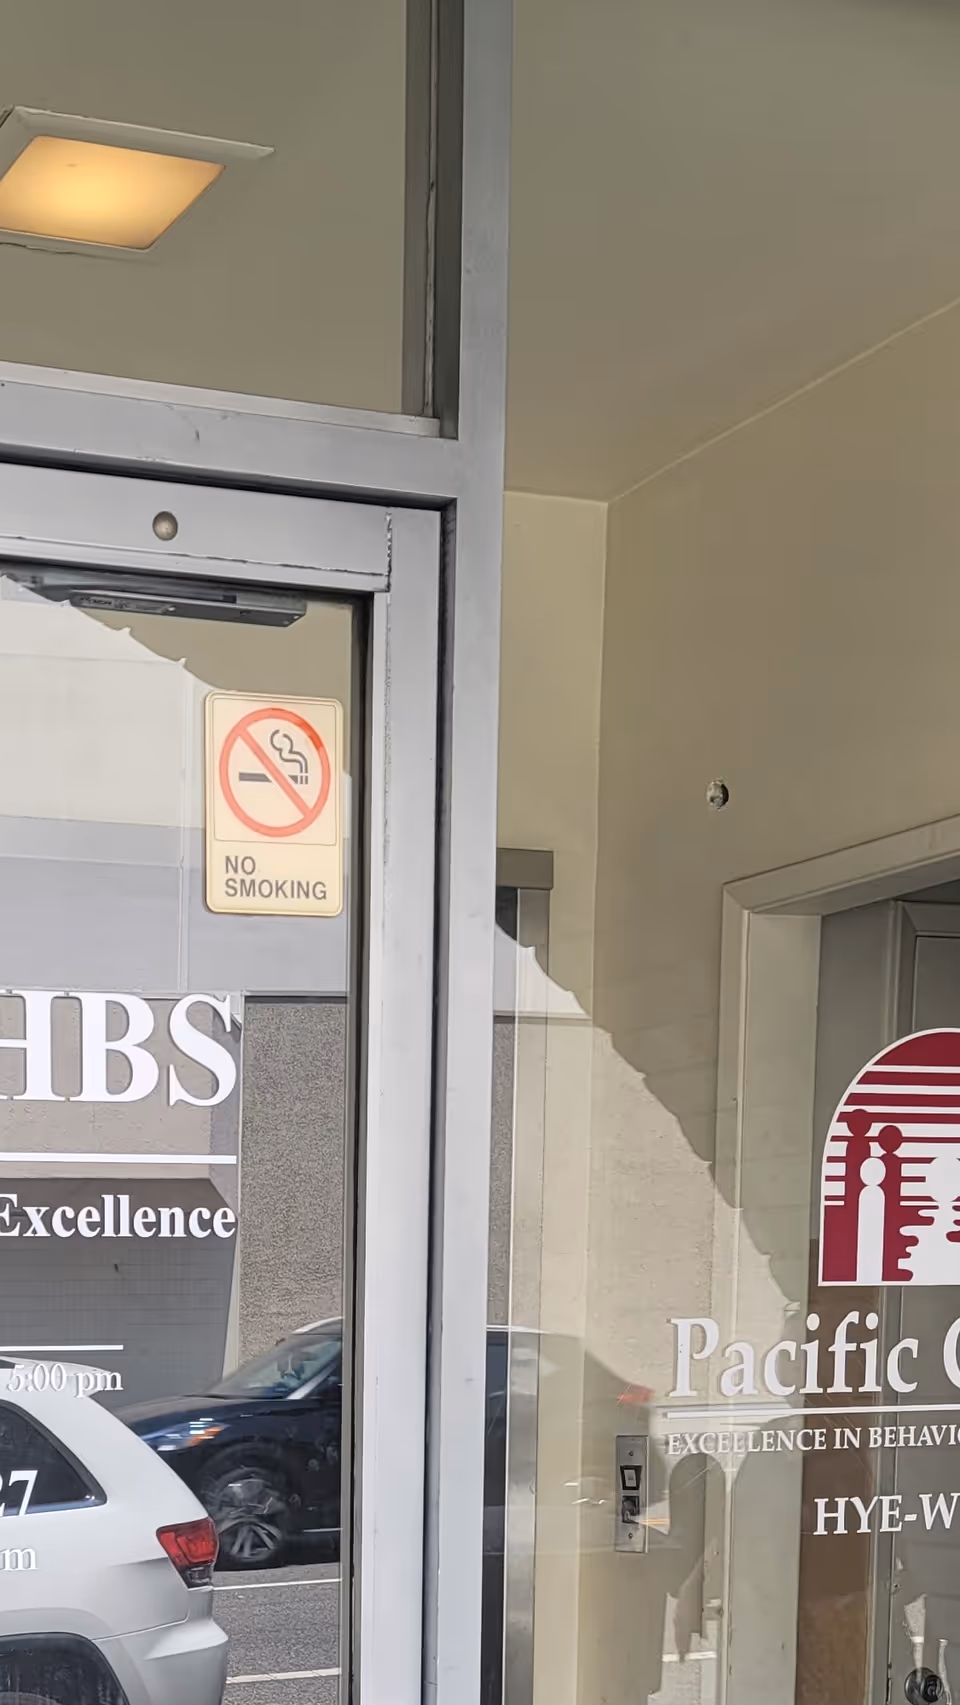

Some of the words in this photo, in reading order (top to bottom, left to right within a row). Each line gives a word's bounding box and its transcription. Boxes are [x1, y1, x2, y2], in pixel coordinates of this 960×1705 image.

[225, 855, 257, 876] NO
[224, 878, 328, 900] SMOKING
[666, 1310, 920, 1399] Pacific
[7, 1363, 67, 1392] 5:00
[74, 1370, 124, 1398] pm
[668, 1427, 828, 1456] EXCELLENCE
[833, 1427, 863, 1449] IN
[813, 1493, 960, 1536] HYE-W
